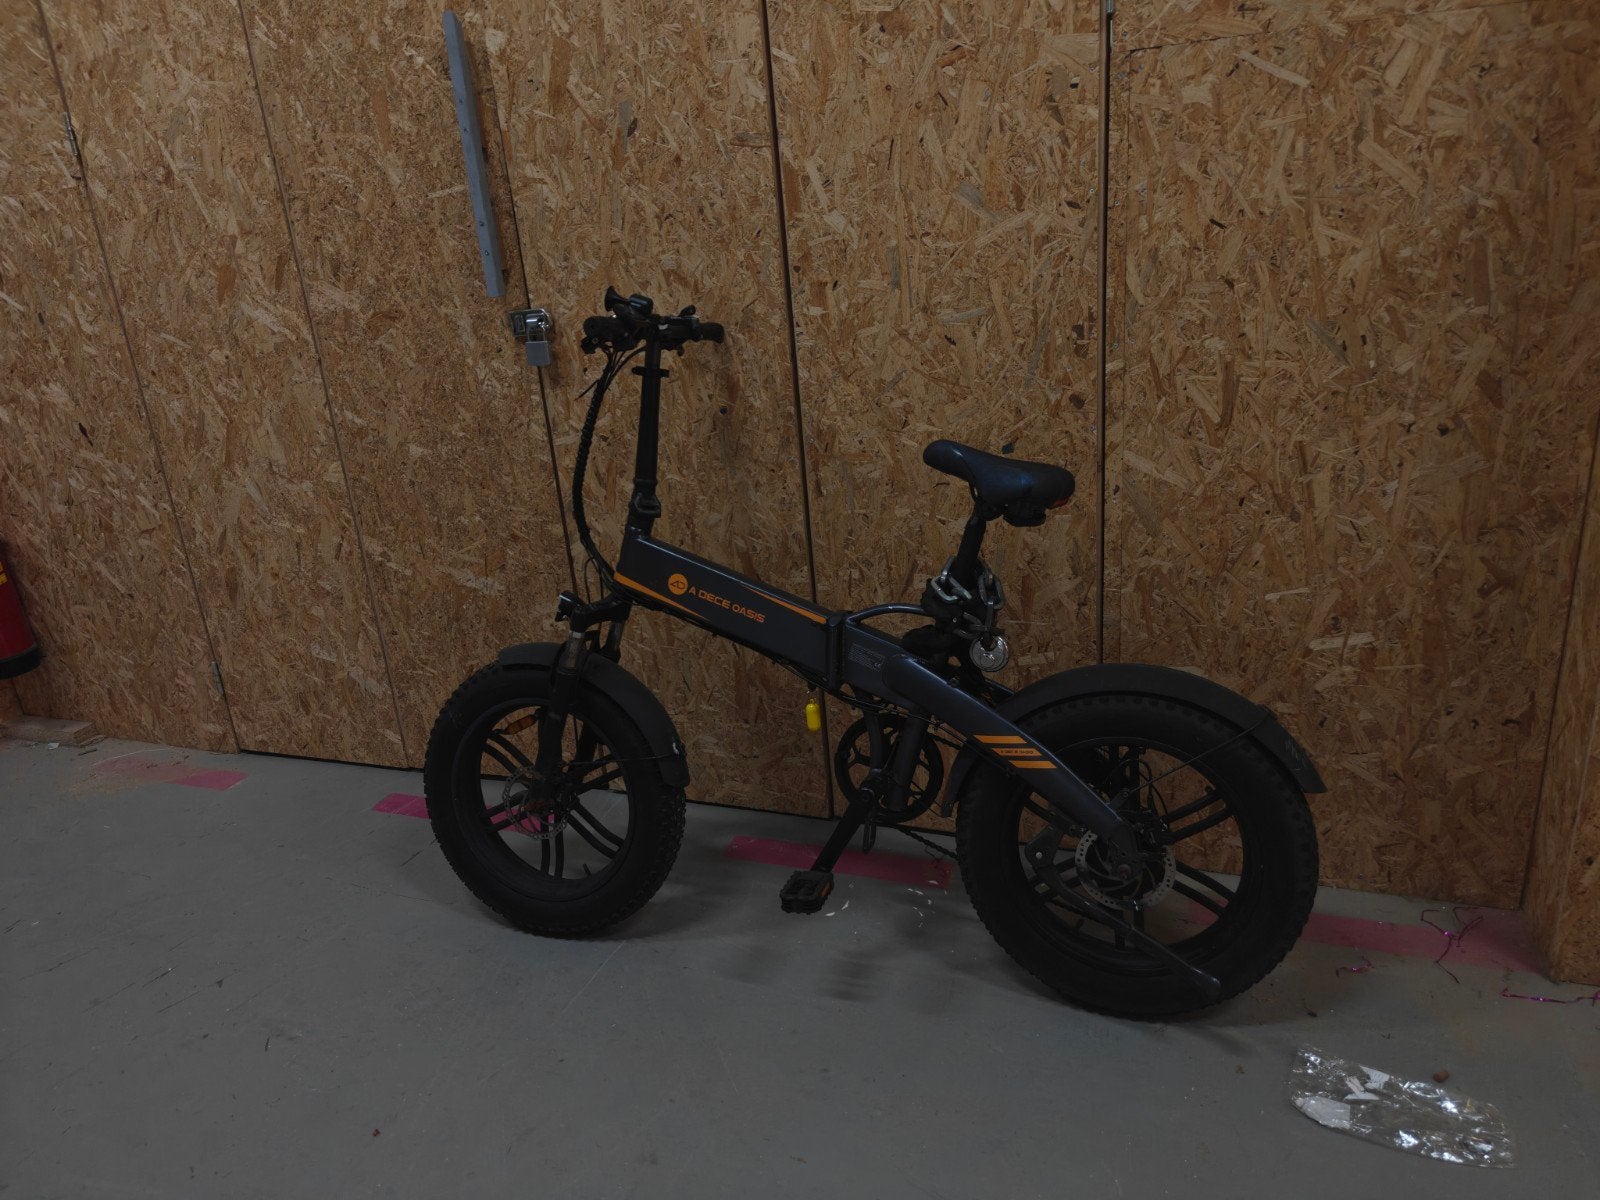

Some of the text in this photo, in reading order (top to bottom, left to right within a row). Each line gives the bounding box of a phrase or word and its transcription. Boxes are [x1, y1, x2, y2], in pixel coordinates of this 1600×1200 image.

[689, 586, 766, 623] A DECE OASIS
